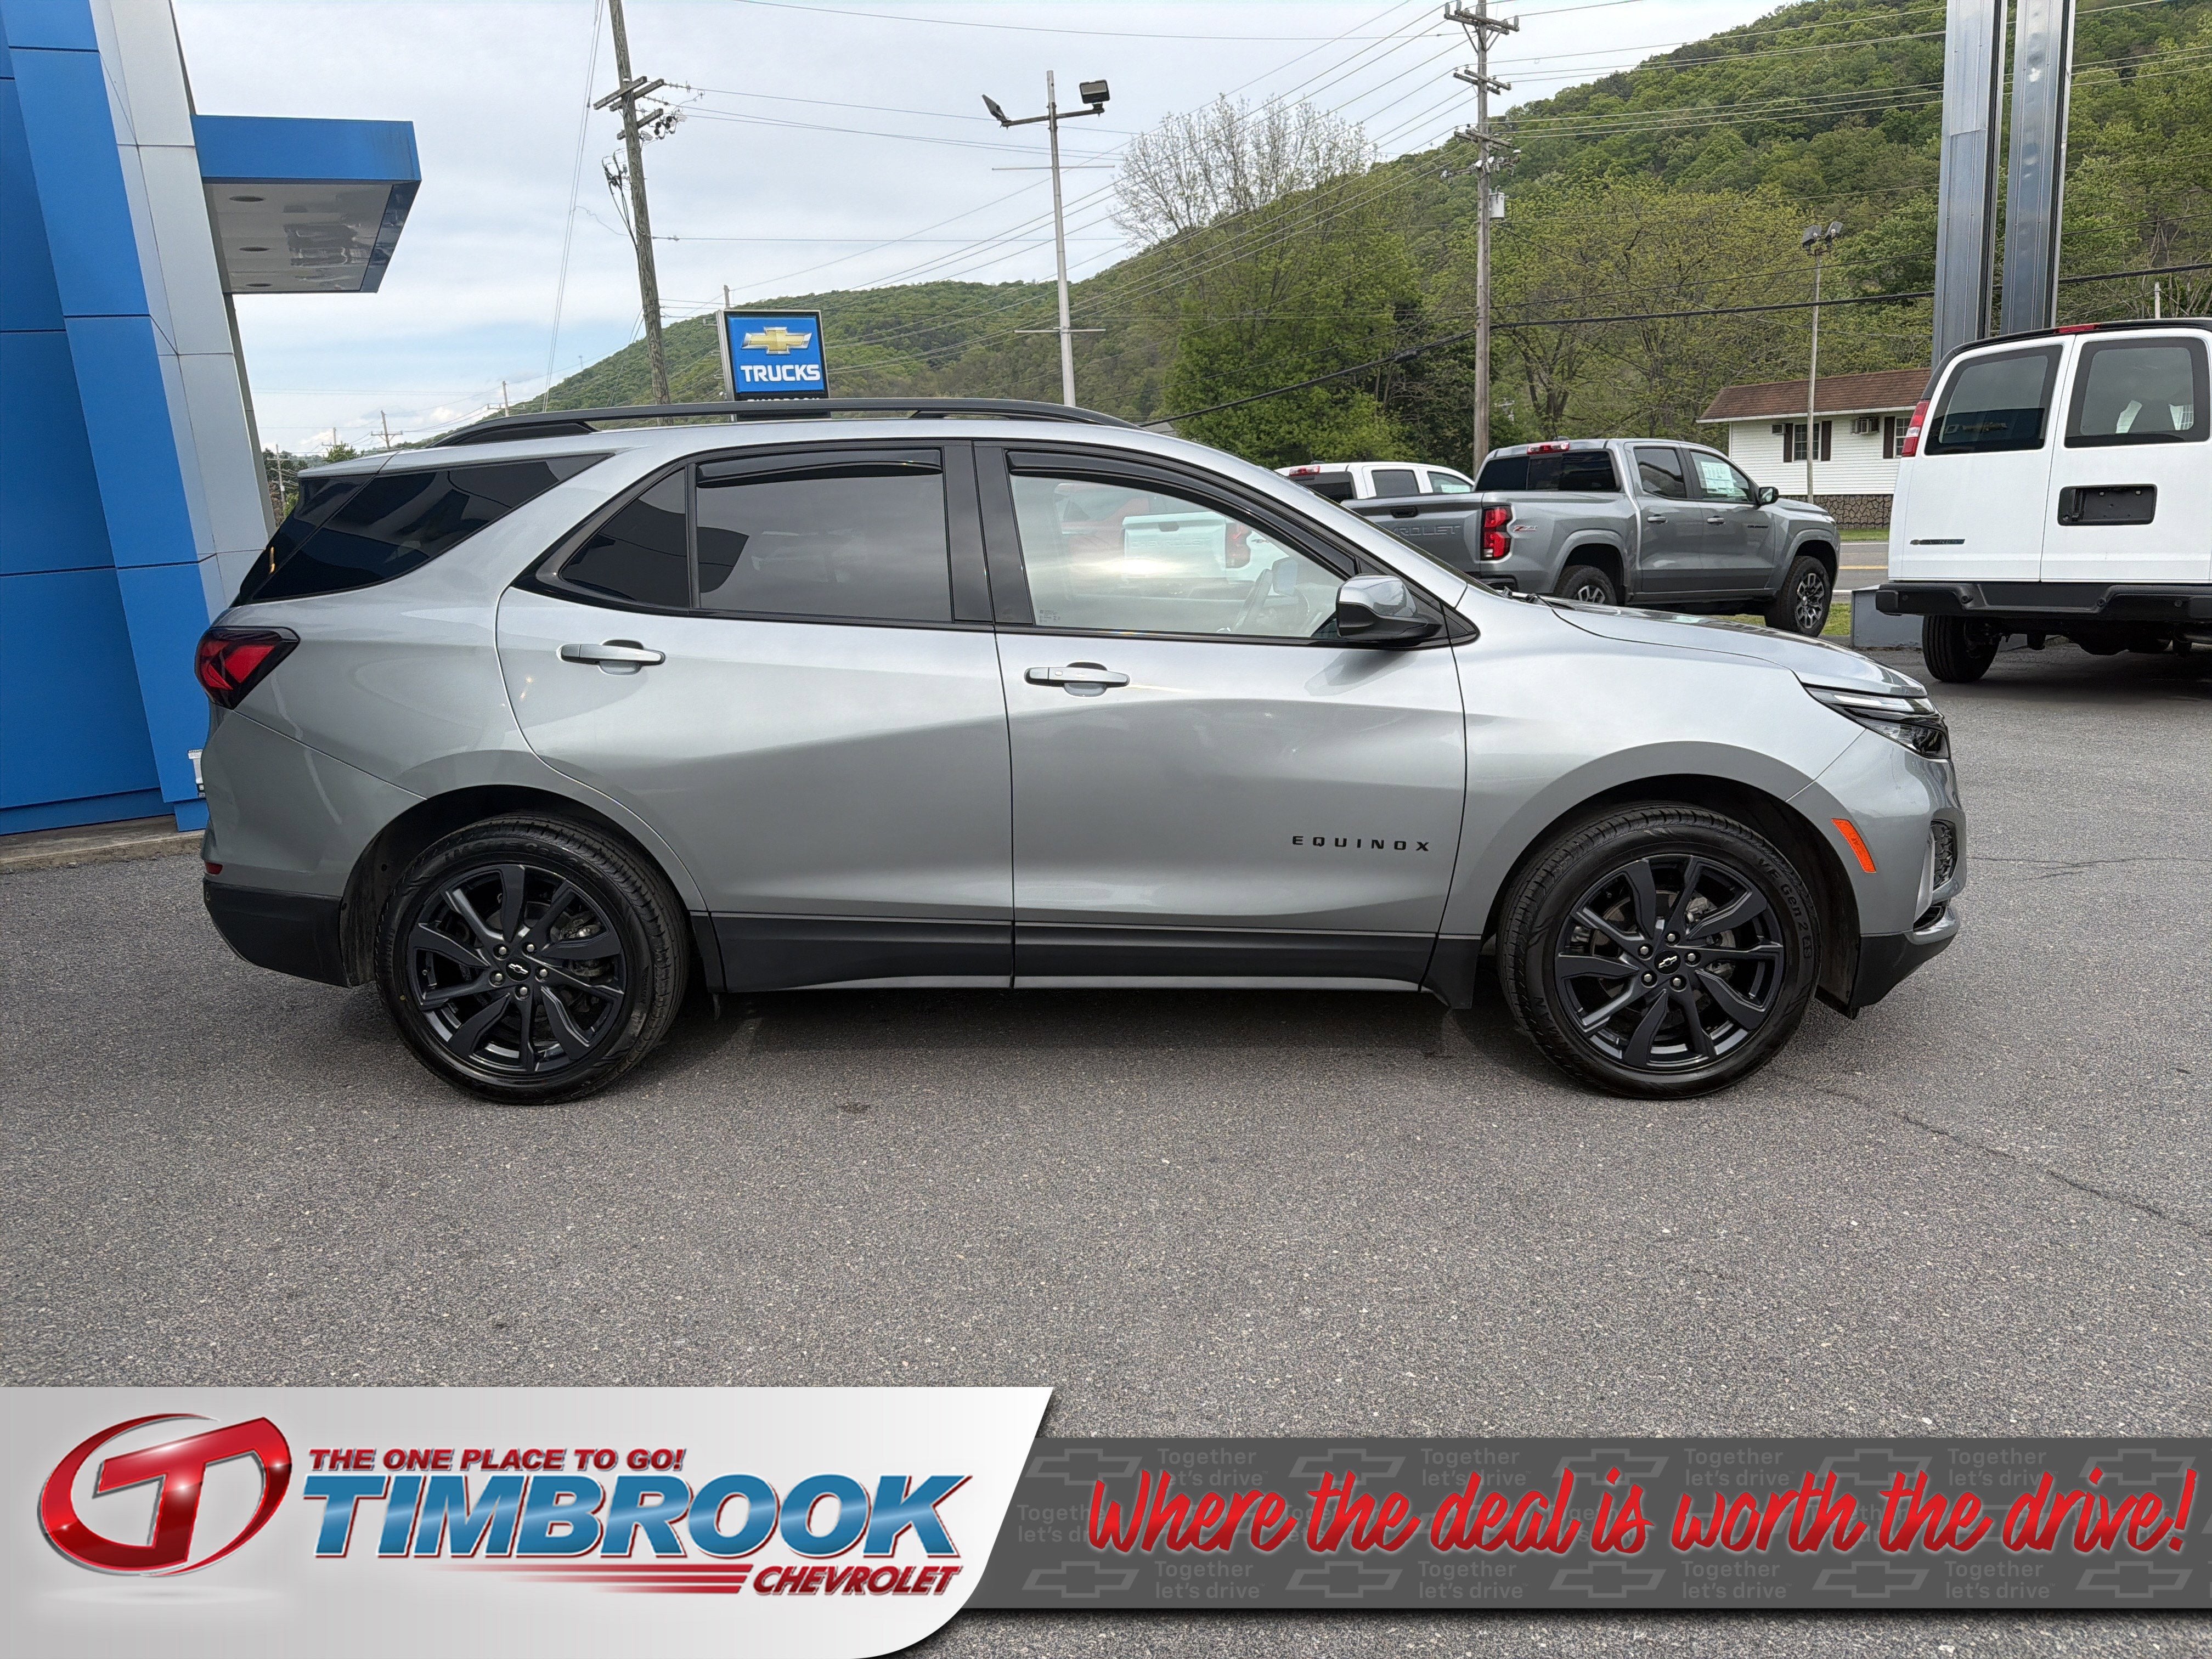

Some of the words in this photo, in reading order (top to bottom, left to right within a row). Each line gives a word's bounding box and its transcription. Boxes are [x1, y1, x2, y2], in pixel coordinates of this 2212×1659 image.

[741, 364, 821, 382] TRUCKS
[1292, 836, 1429, 851] EQUINOX
[1780, 883, 1802, 917] Gen
[1798, 922, 1809, 931] 2
